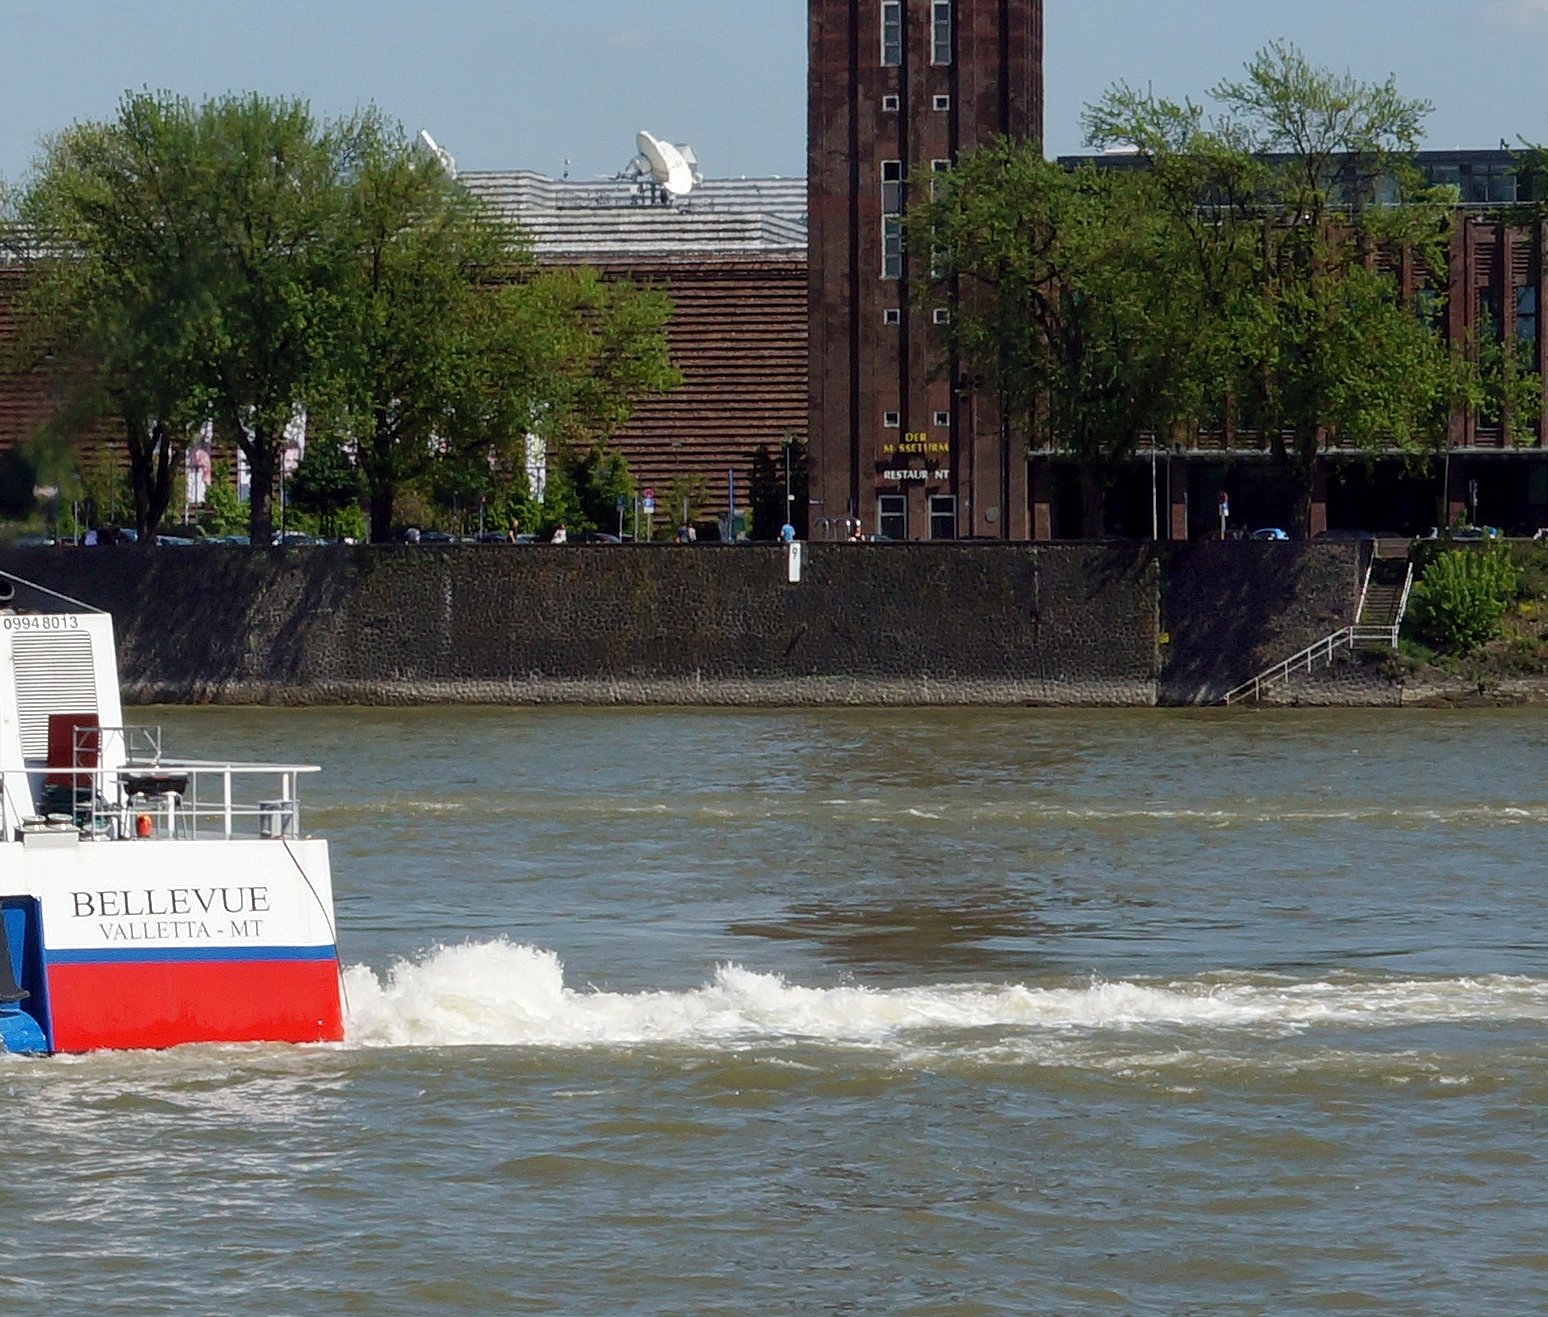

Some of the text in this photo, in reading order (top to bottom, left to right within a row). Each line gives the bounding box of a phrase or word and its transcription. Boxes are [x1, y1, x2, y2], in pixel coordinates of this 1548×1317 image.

[904, 432, 927, 442] DER
[883, 443, 950, 453] MSSETURM
[883, 469, 950, 480] RESTAURNT
[69, 886, 271, 918] BELLEVUE
[99, 920, 211, 940] VALLETTA
[229, 919, 264, 937] MT
